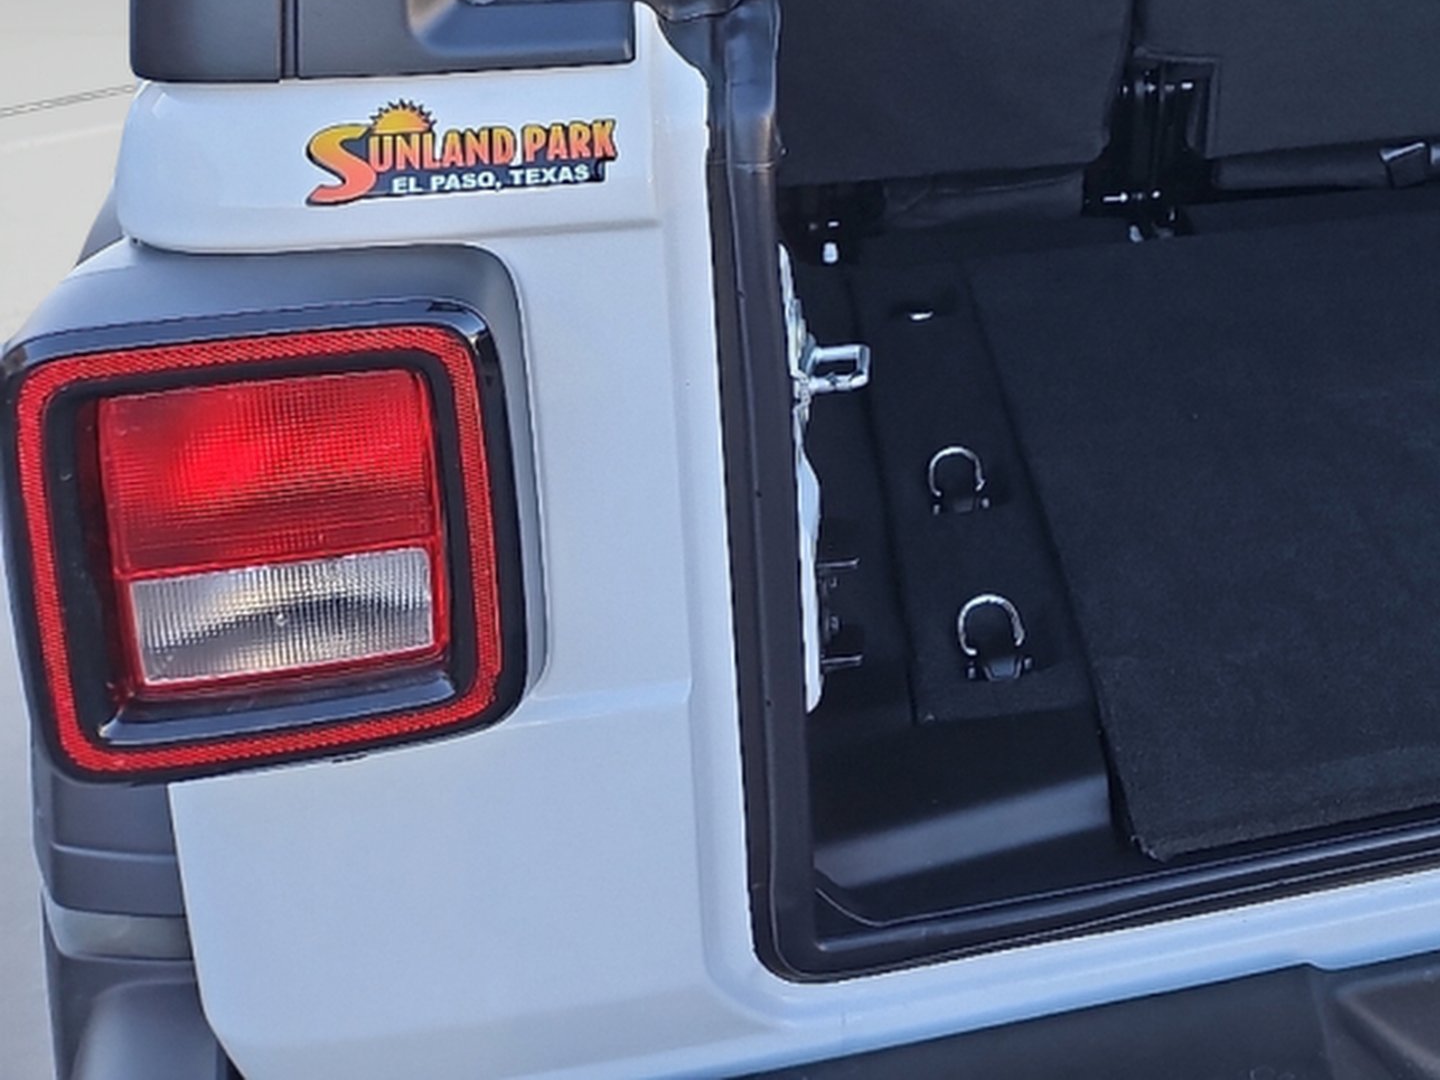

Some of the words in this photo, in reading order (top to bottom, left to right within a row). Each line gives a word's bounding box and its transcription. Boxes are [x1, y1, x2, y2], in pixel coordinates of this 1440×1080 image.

[306, 123, 517, 206] SUNLAND
[522, 119, 617, 163] PARK
[392, 176, 425, 194] EL
[430, 171, 502, 192] PASO,
[509, 163, 590, 185] TEXAS
